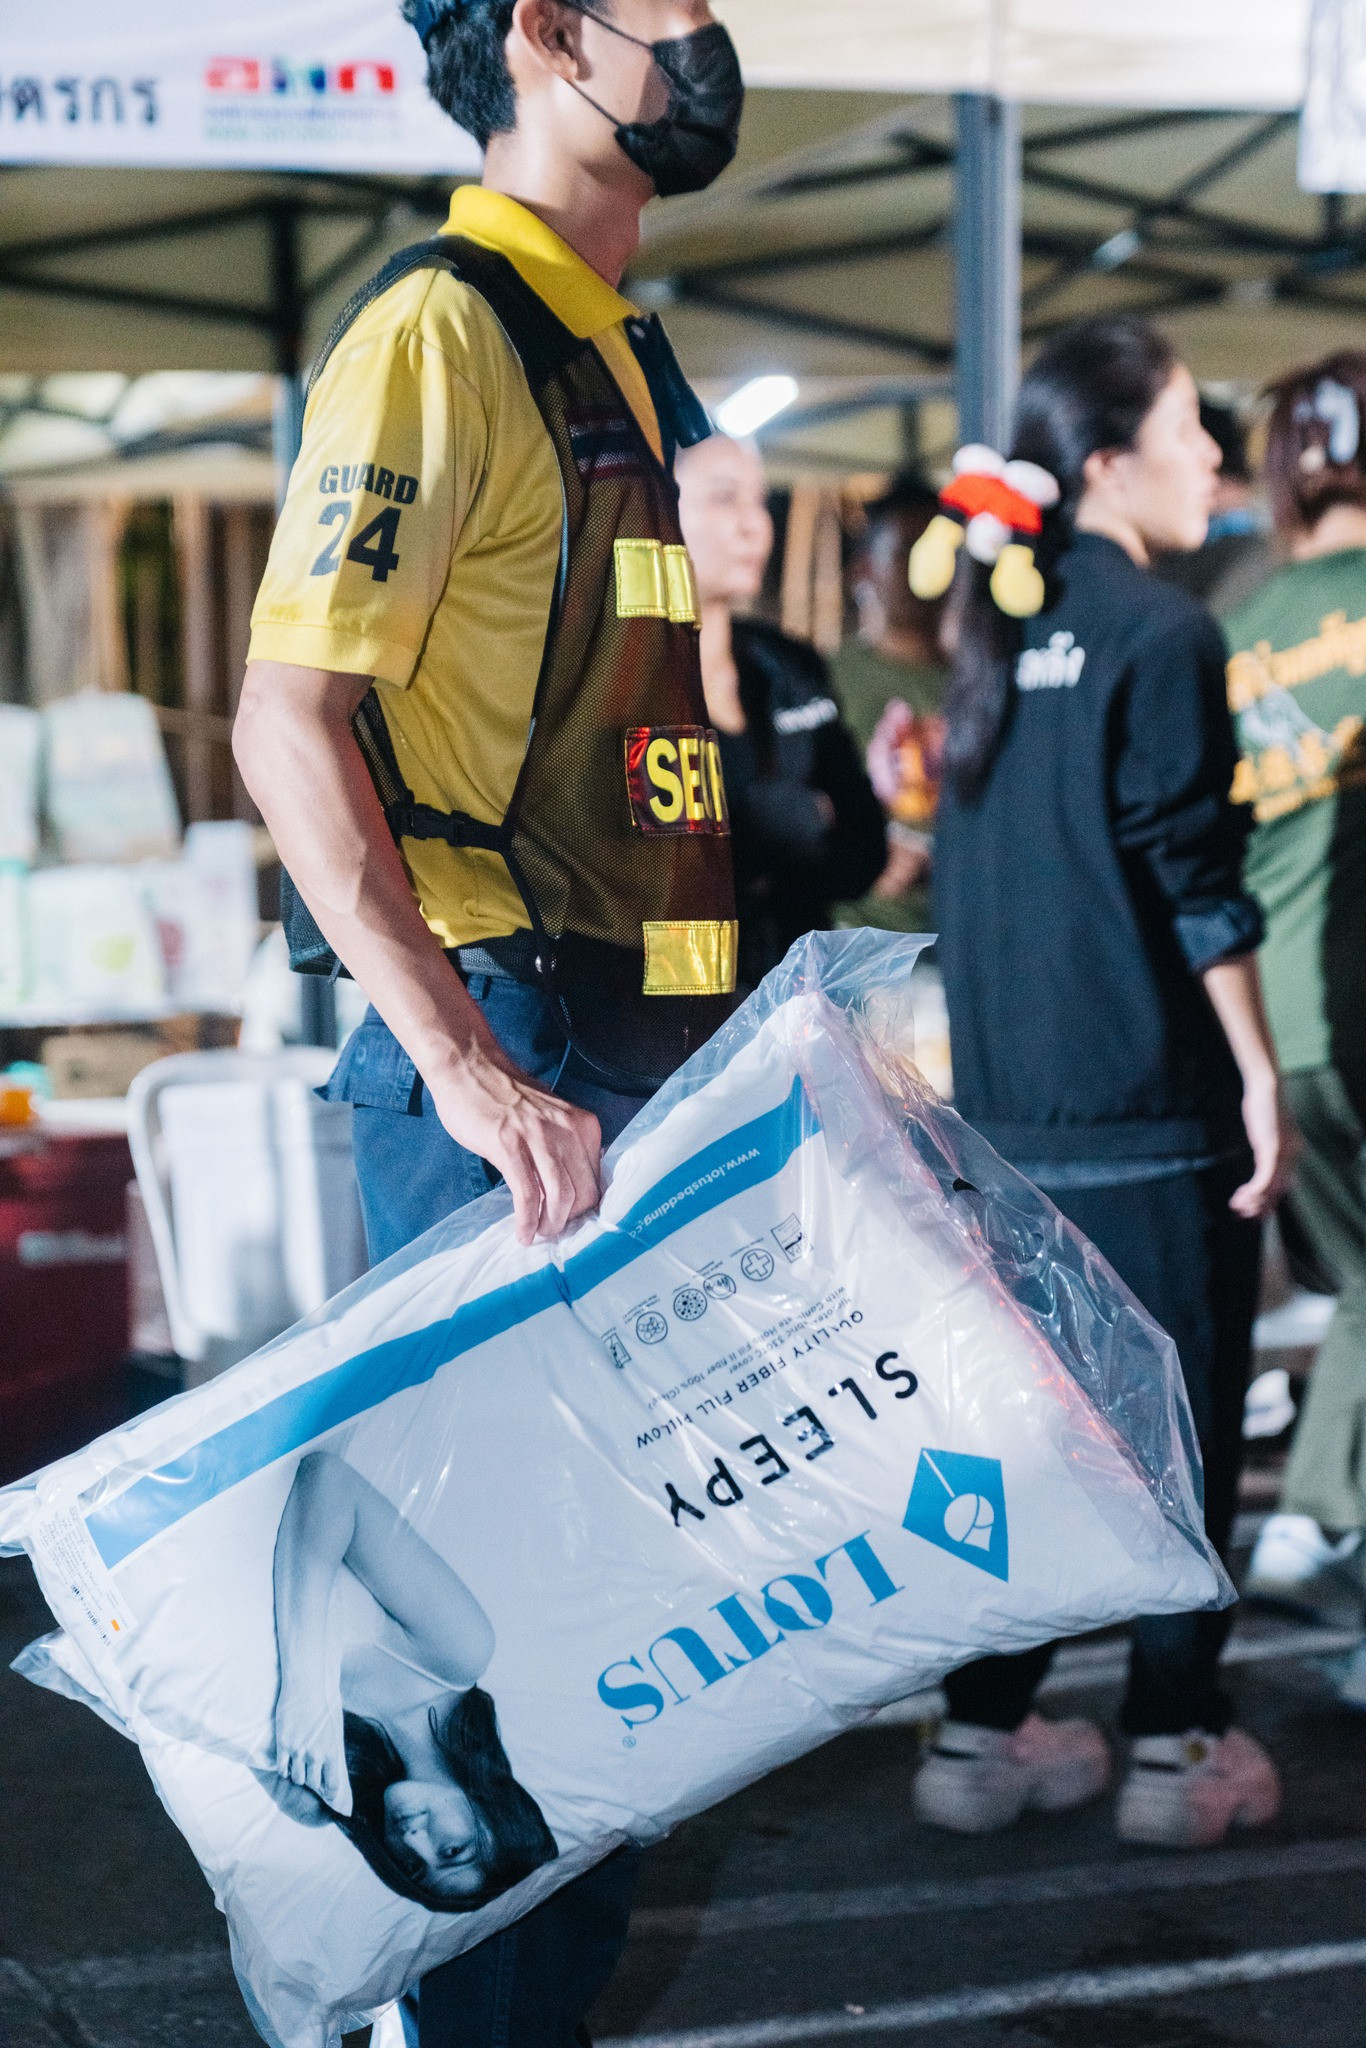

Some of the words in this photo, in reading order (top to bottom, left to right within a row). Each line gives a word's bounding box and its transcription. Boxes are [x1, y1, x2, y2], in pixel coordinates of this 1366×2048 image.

[319, 463, 419, 504] GUARD
[310, 500, 402, 582] 24
[680, 1372, 705, 1389] 100%
[707, 1358, 728, 1375] fiber
[729, 1355, 754, 1374] cover
[736, 1356, 787, 1394] FIBER
[696, 1390, 733, 1415] FILL
[637, 1413, 694, 1449] PILLOW
[665, 1351, 919, 1527] SLEEPY
[597, 1529, 906, 1730] LOTUS
